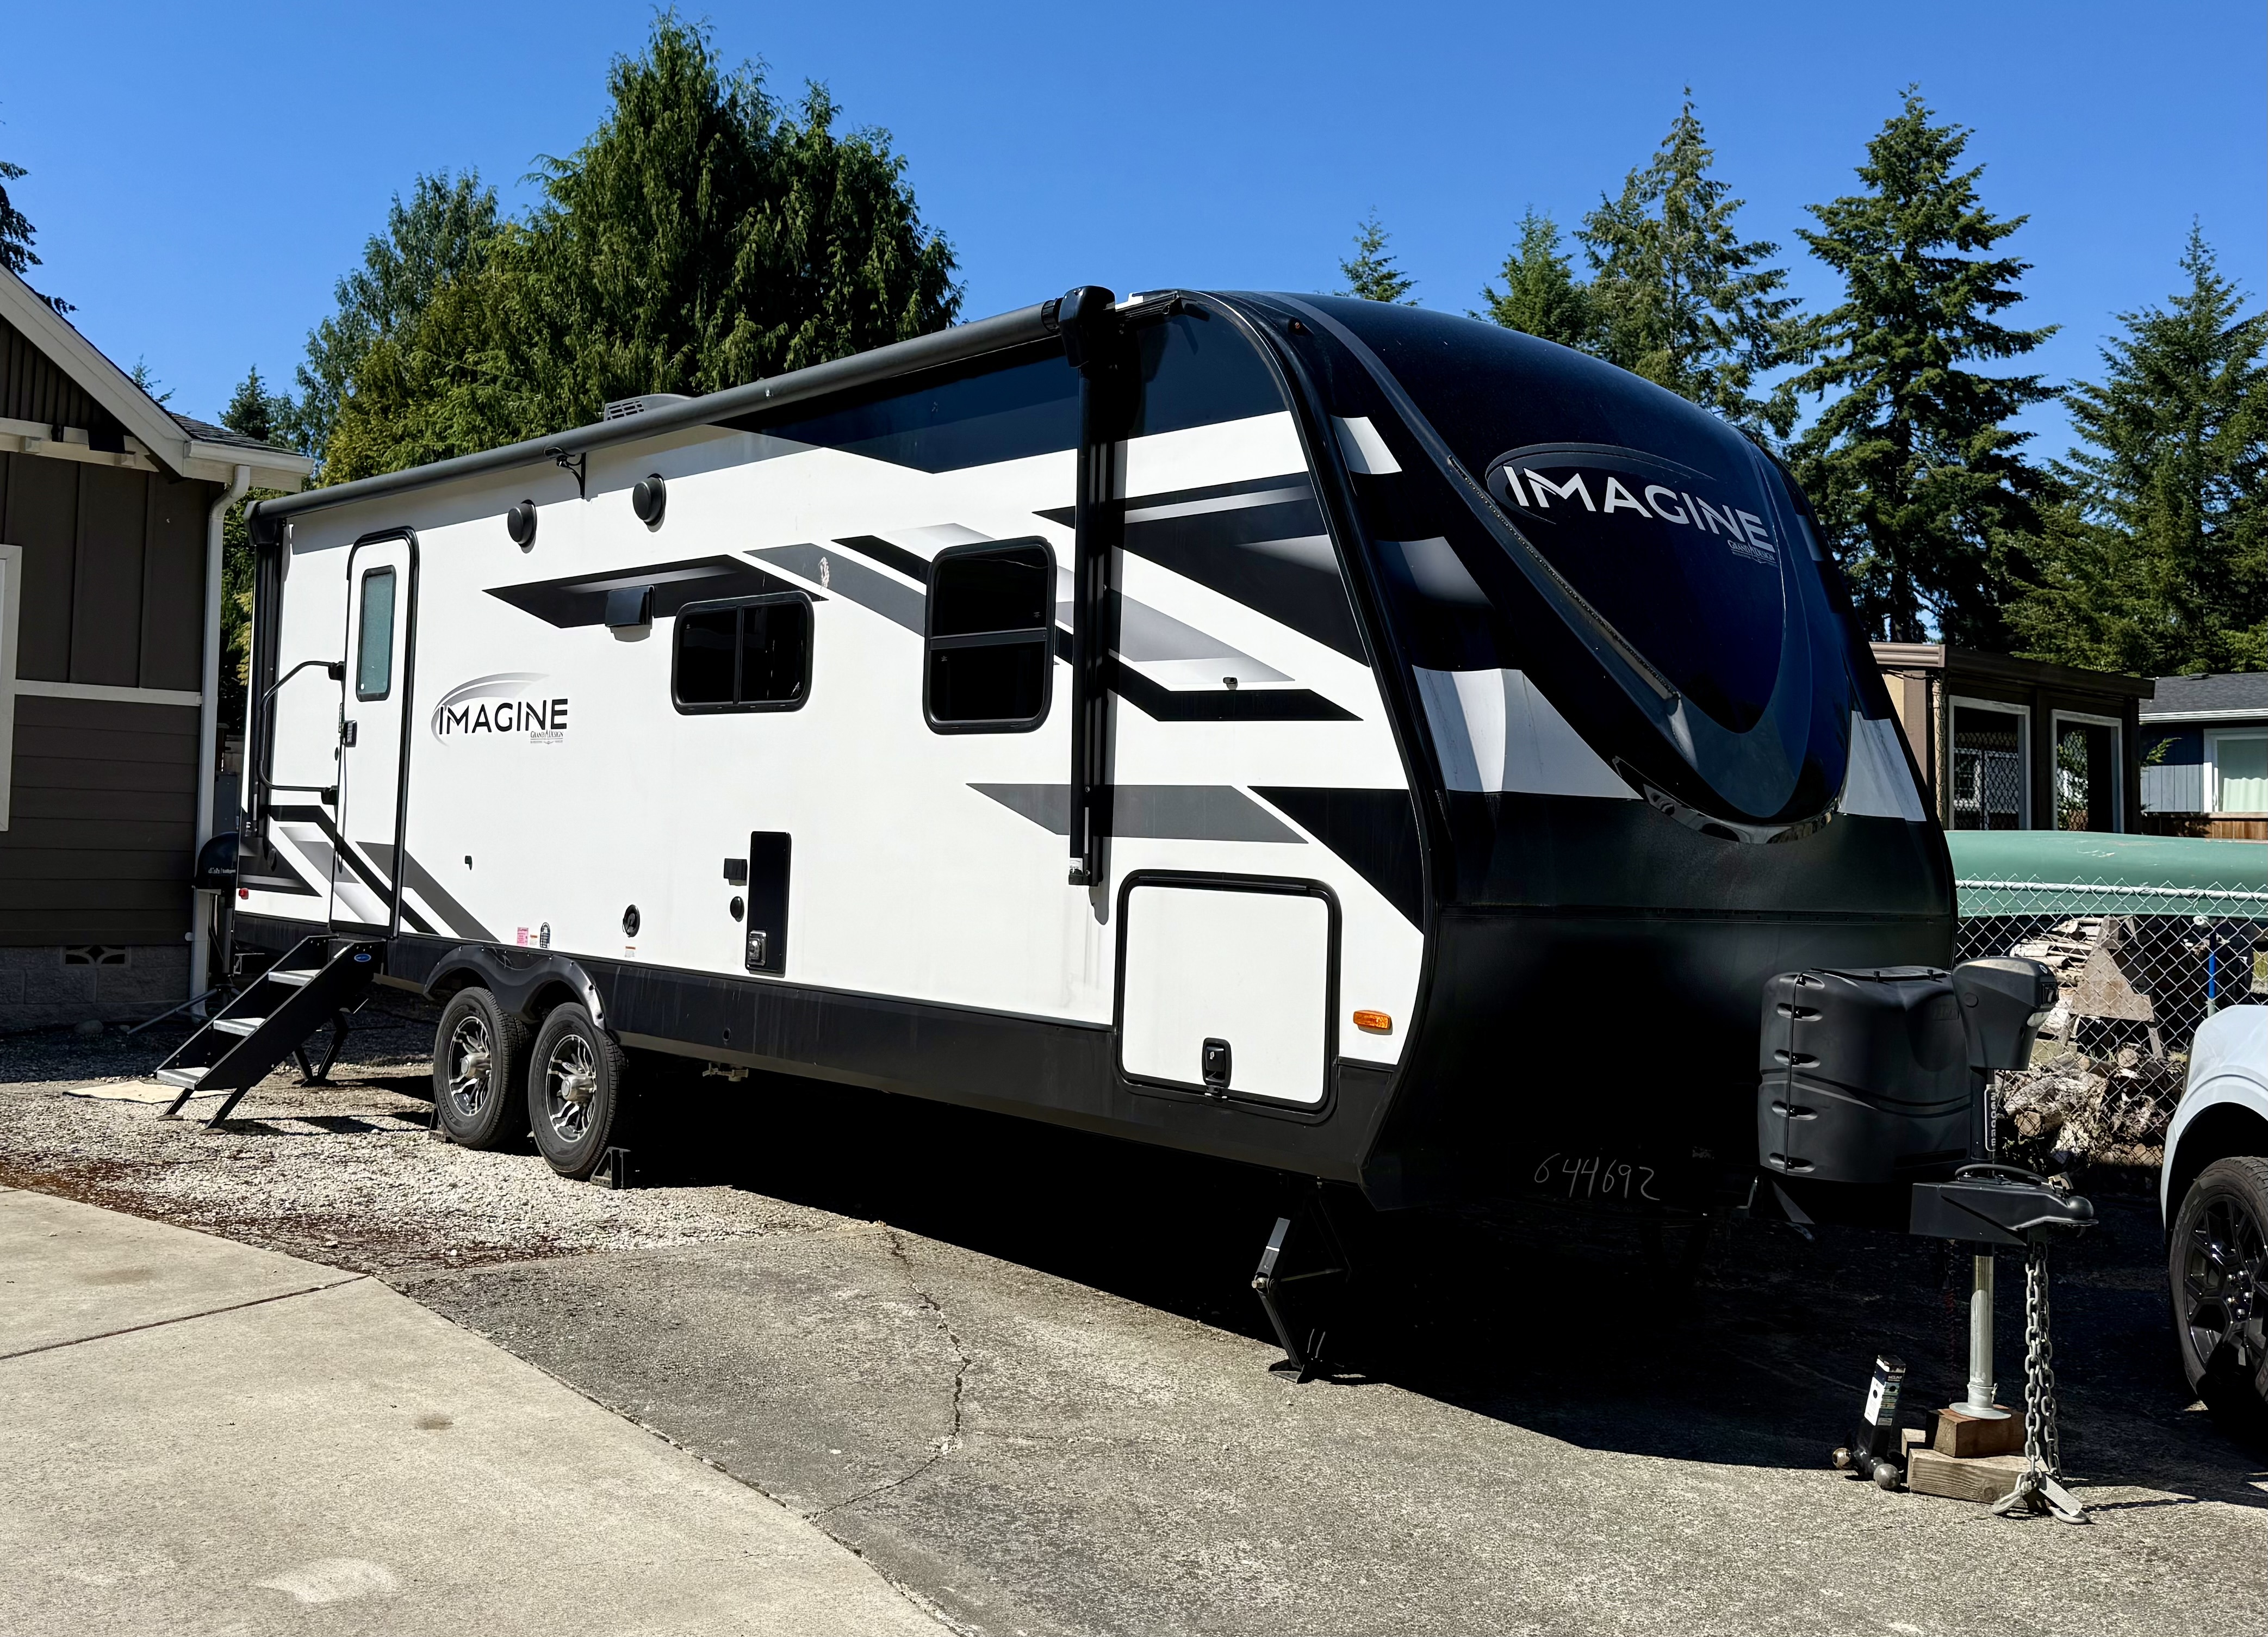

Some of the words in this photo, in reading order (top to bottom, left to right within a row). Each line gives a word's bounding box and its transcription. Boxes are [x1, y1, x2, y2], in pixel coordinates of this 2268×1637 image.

[1503, 465, 1775, 553] IMAGINE
[439, 698, 568, 735] IMAGINE
[1534, 1153, 1660, 1200] 644692
